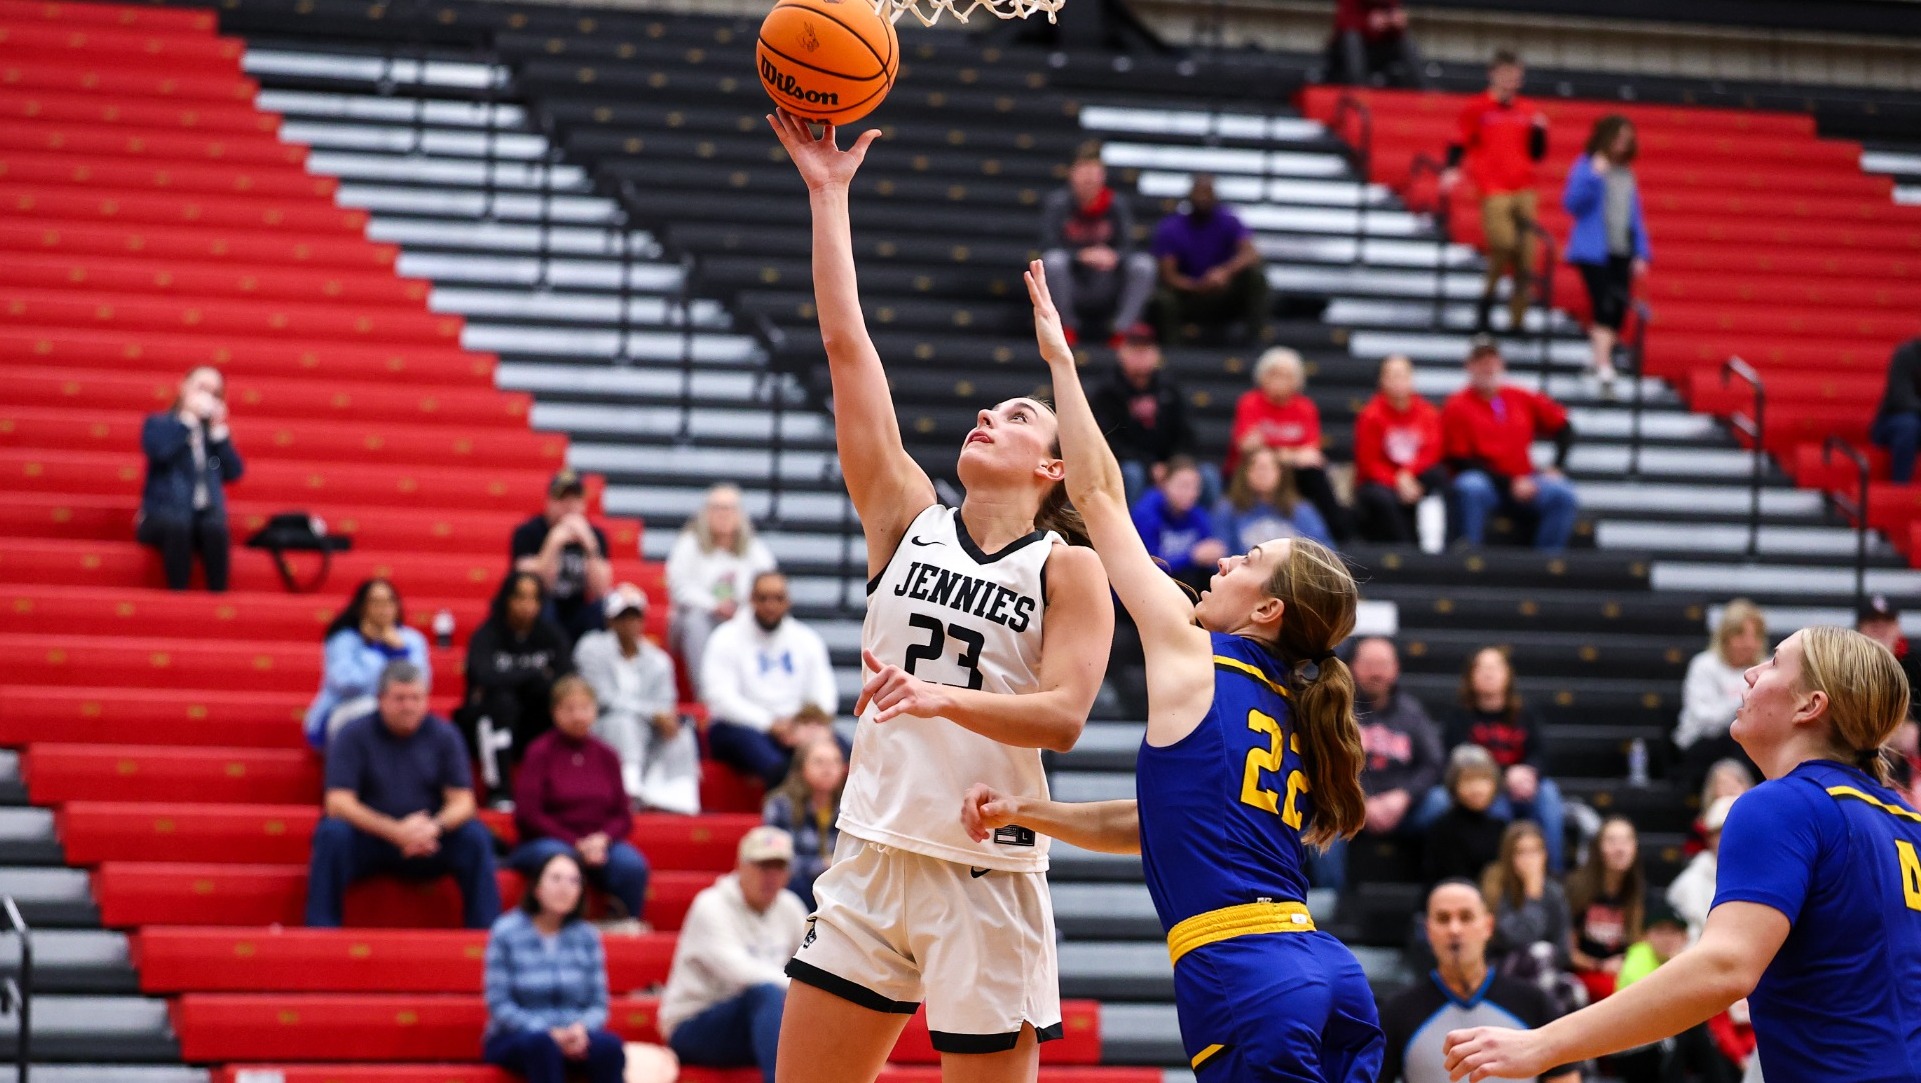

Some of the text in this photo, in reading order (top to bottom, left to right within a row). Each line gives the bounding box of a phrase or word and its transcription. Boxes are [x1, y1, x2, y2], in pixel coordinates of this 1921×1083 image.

[761, 54, 839, 106] Wilson
[894, 561, 1036, 633] JENNIES
[904, 612, 985, 692] 23
